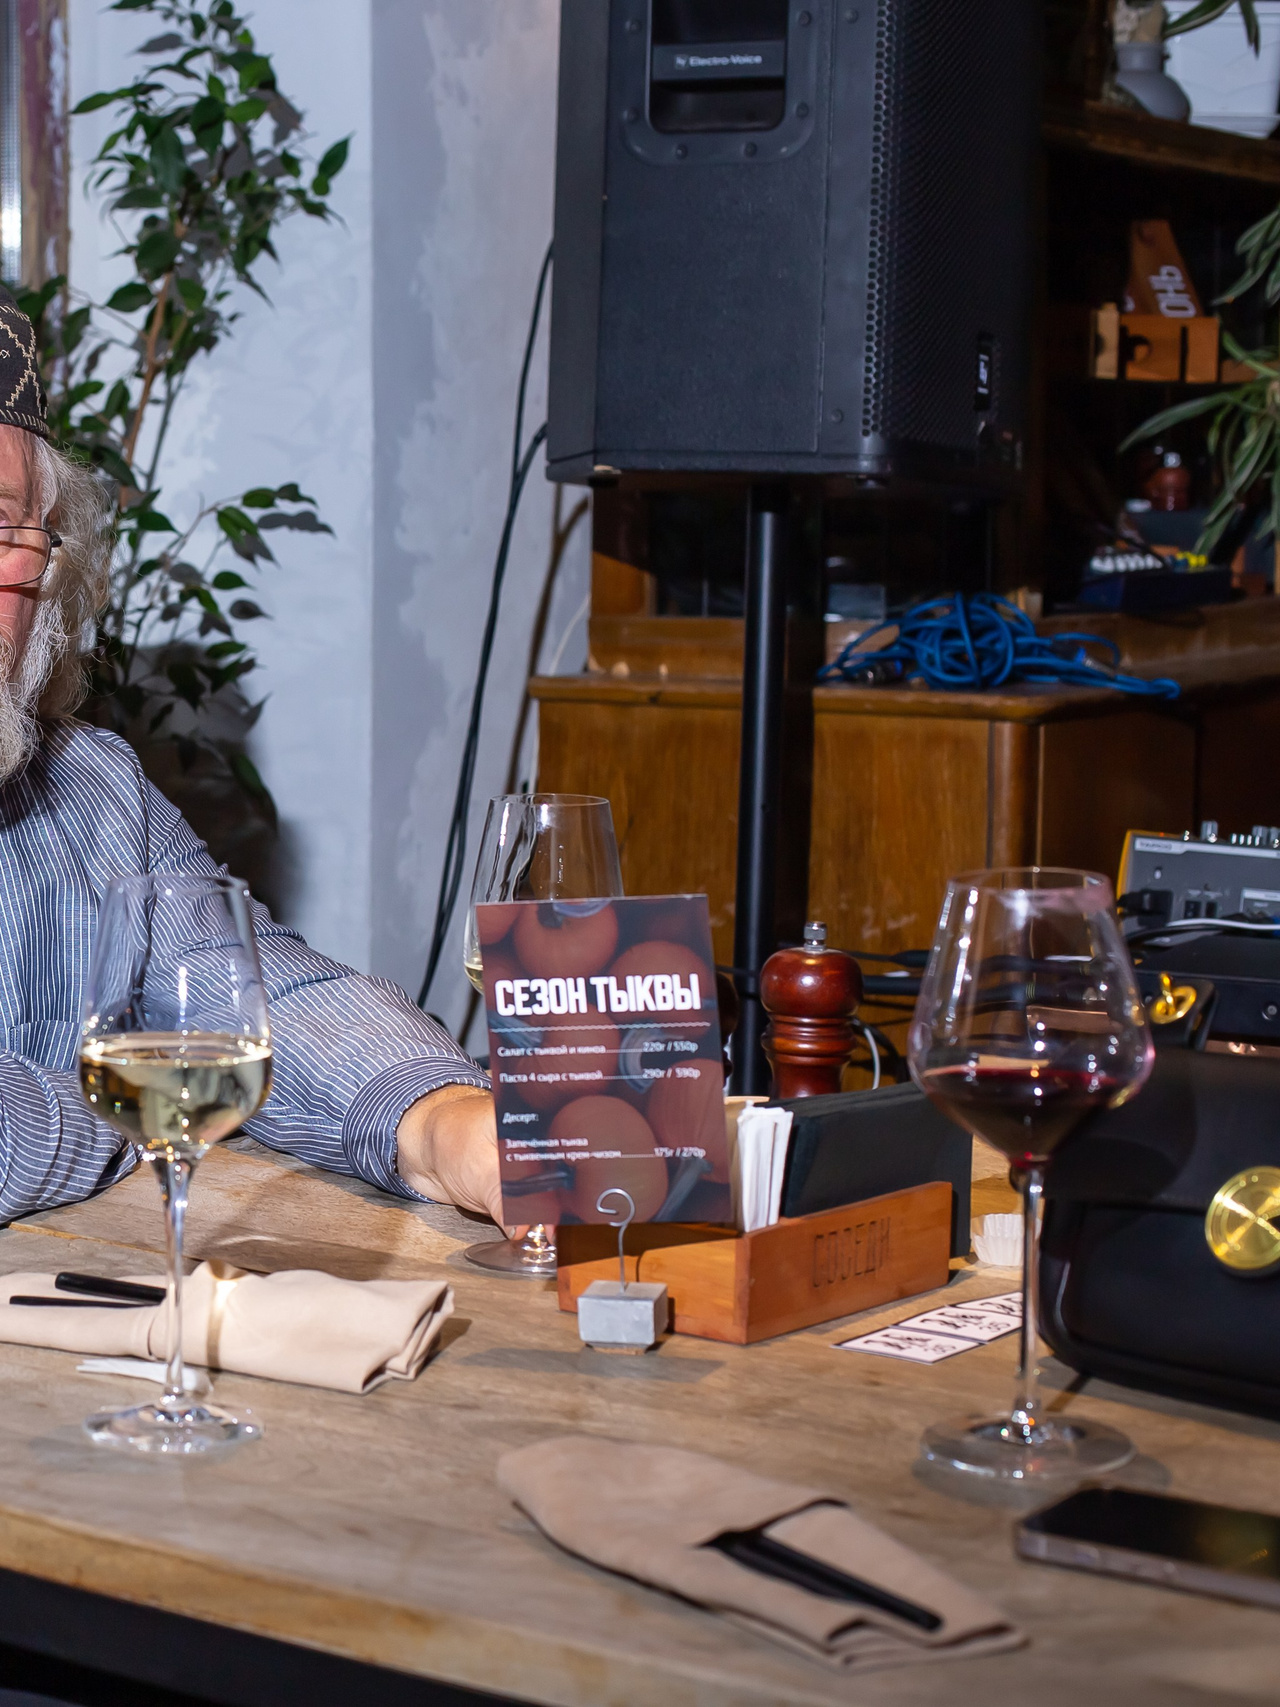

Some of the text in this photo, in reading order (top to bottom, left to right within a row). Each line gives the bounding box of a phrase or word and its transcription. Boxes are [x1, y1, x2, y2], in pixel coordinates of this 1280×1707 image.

[495, 973, 702, 1016] СЕЗОН ТЫКВЫ
[497, 1046, 525, 1057] Салат
[499, 1072, 528, 1083] Паста
[529, 1072, 536, 1082] 4
[536, 1072, 560, 1084] сыра
